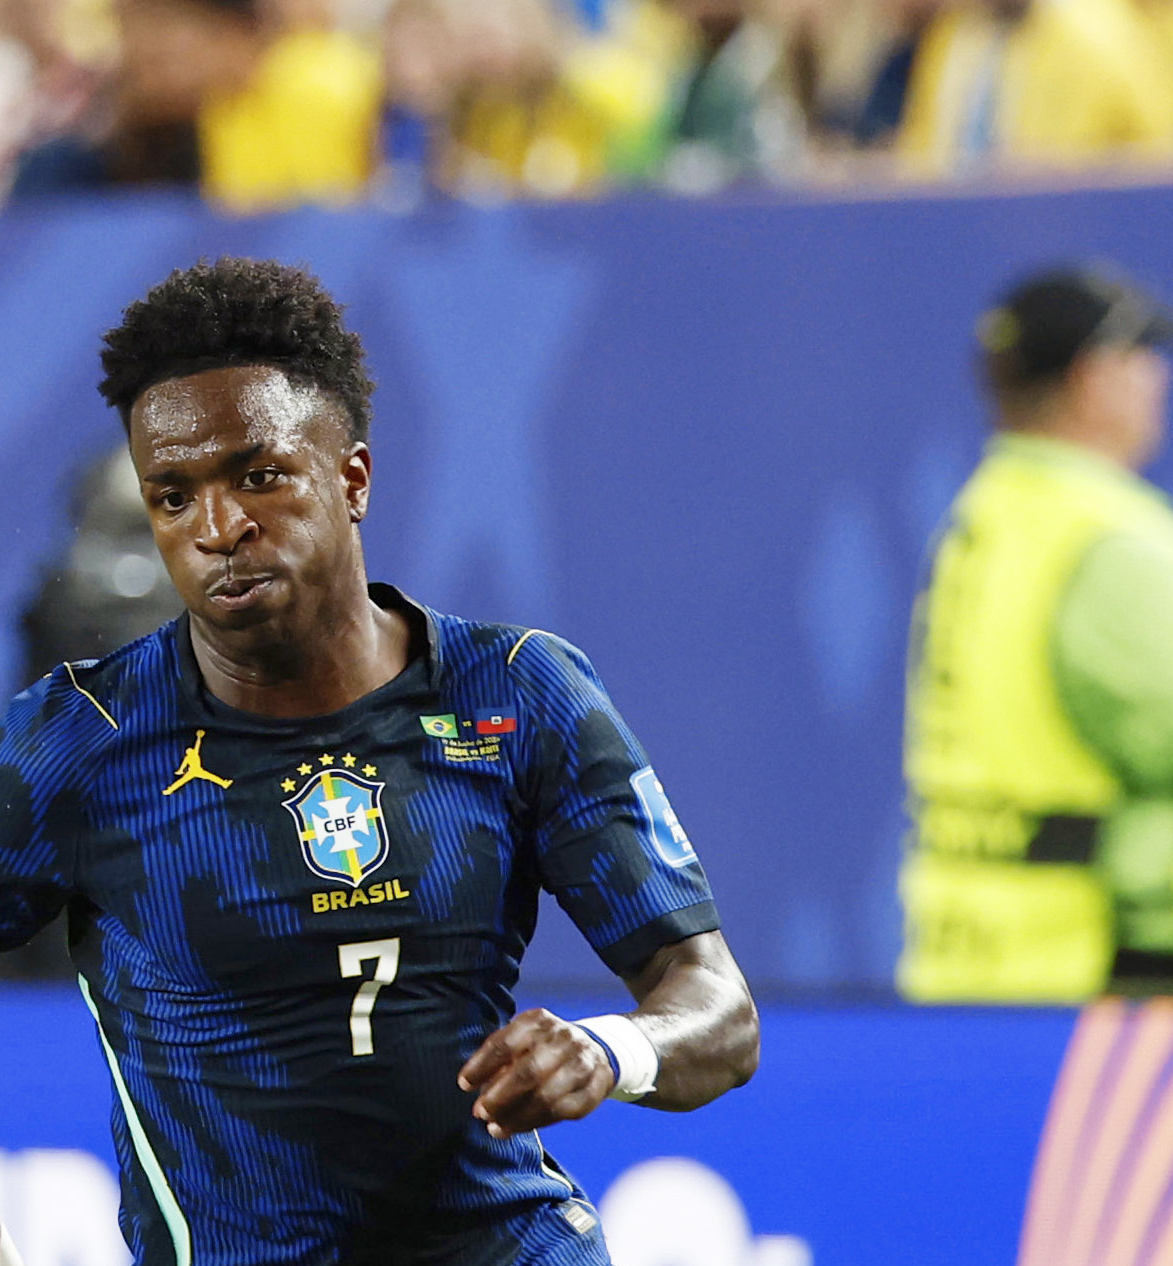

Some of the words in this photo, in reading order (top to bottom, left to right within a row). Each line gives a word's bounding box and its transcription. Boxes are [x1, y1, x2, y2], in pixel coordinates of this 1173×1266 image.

[323, 815, 357, 834] CBF
[312, 878, 410, 914] BRASIL
[338, 937, 401, 1057] 7
